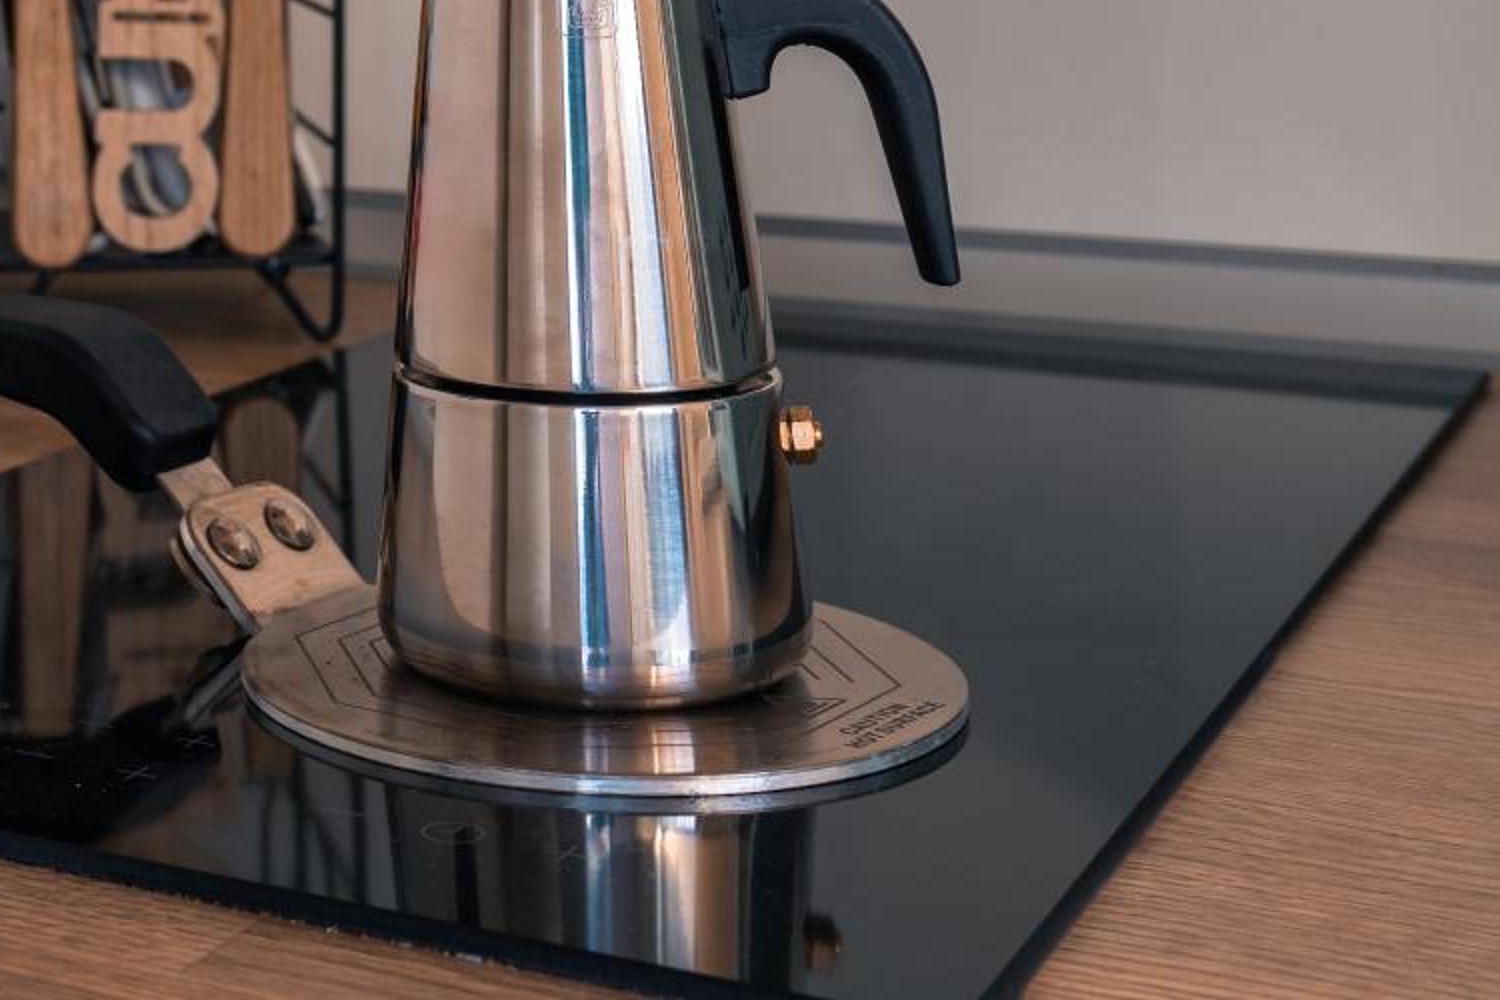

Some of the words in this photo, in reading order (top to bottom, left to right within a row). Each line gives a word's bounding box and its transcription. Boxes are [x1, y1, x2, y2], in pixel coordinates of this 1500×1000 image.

[838, 703, 911, 735] CAUTION
[842, 731, 885, 749] HOT
[873, 700, 948, 734] SURFACE
